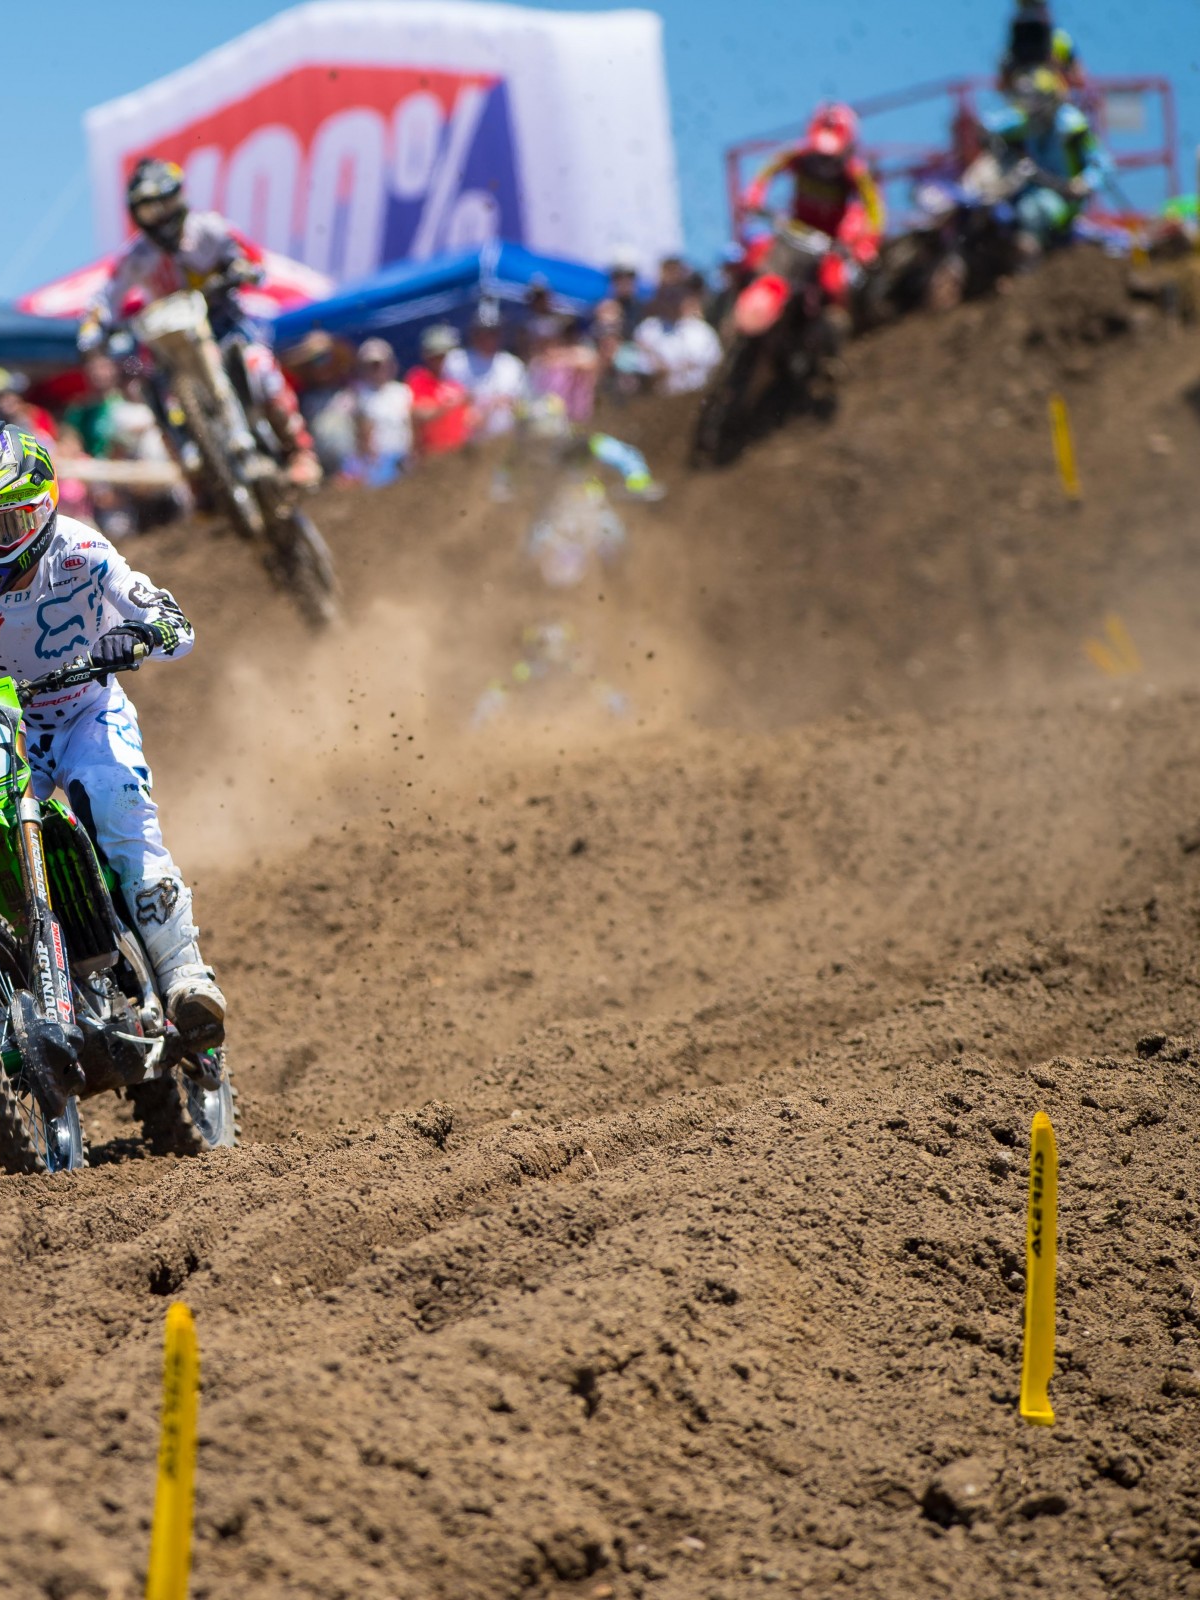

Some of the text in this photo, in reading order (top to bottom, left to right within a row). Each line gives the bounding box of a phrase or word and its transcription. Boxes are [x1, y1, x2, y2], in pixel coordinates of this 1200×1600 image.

[180, 84, 501, 281] 100%
[4, 590, 32, 604] FOX
[65, 671, 91, 683] ARC
[29, 684, 90, 709] CIRCUIT
[51, 921, 65, 971] BRAKING
[36, 940, 58, 1024] DUNLOP
